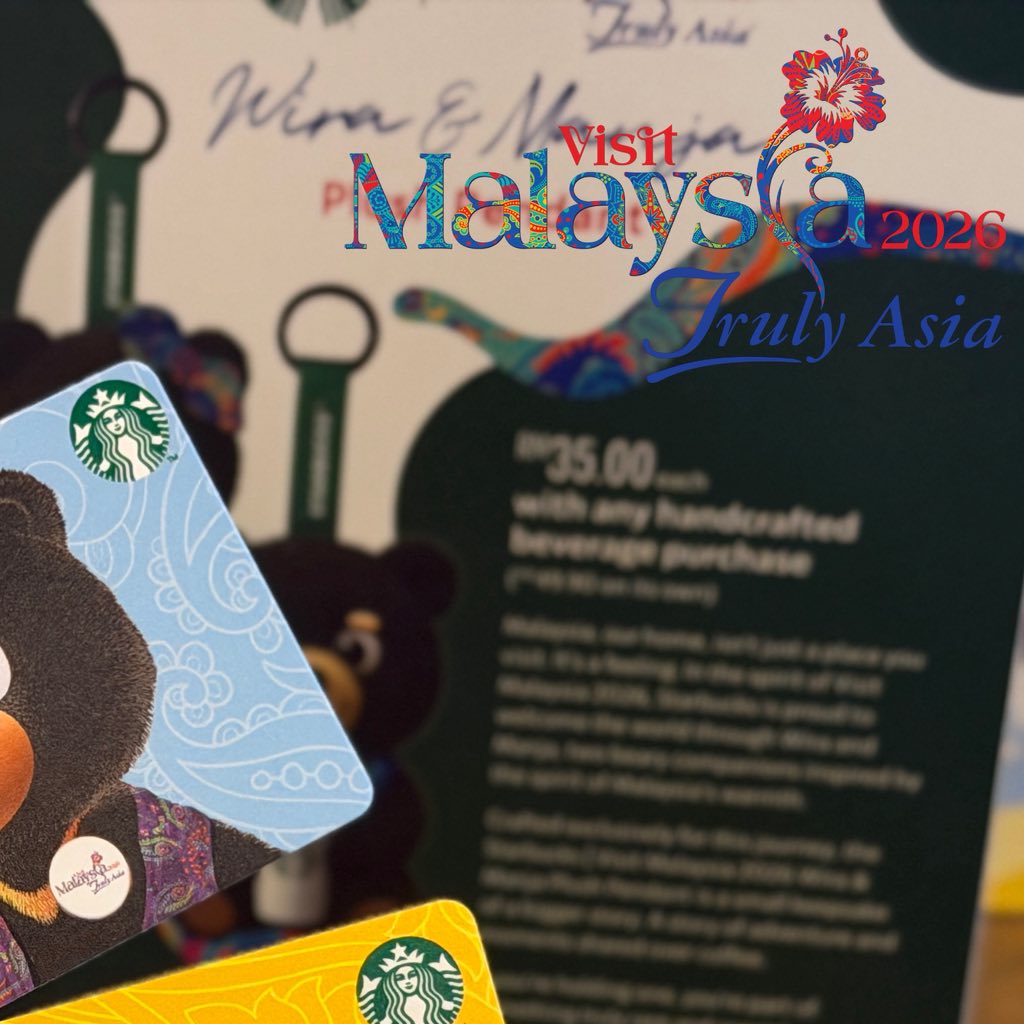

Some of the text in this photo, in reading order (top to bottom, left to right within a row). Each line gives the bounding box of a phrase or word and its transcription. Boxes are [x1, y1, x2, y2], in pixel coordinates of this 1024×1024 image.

[206, 58, 411, 150] Wira
[511, 492, 862, 544] with any handcrafted
[508, 523, 814, 579] beverage purchase
